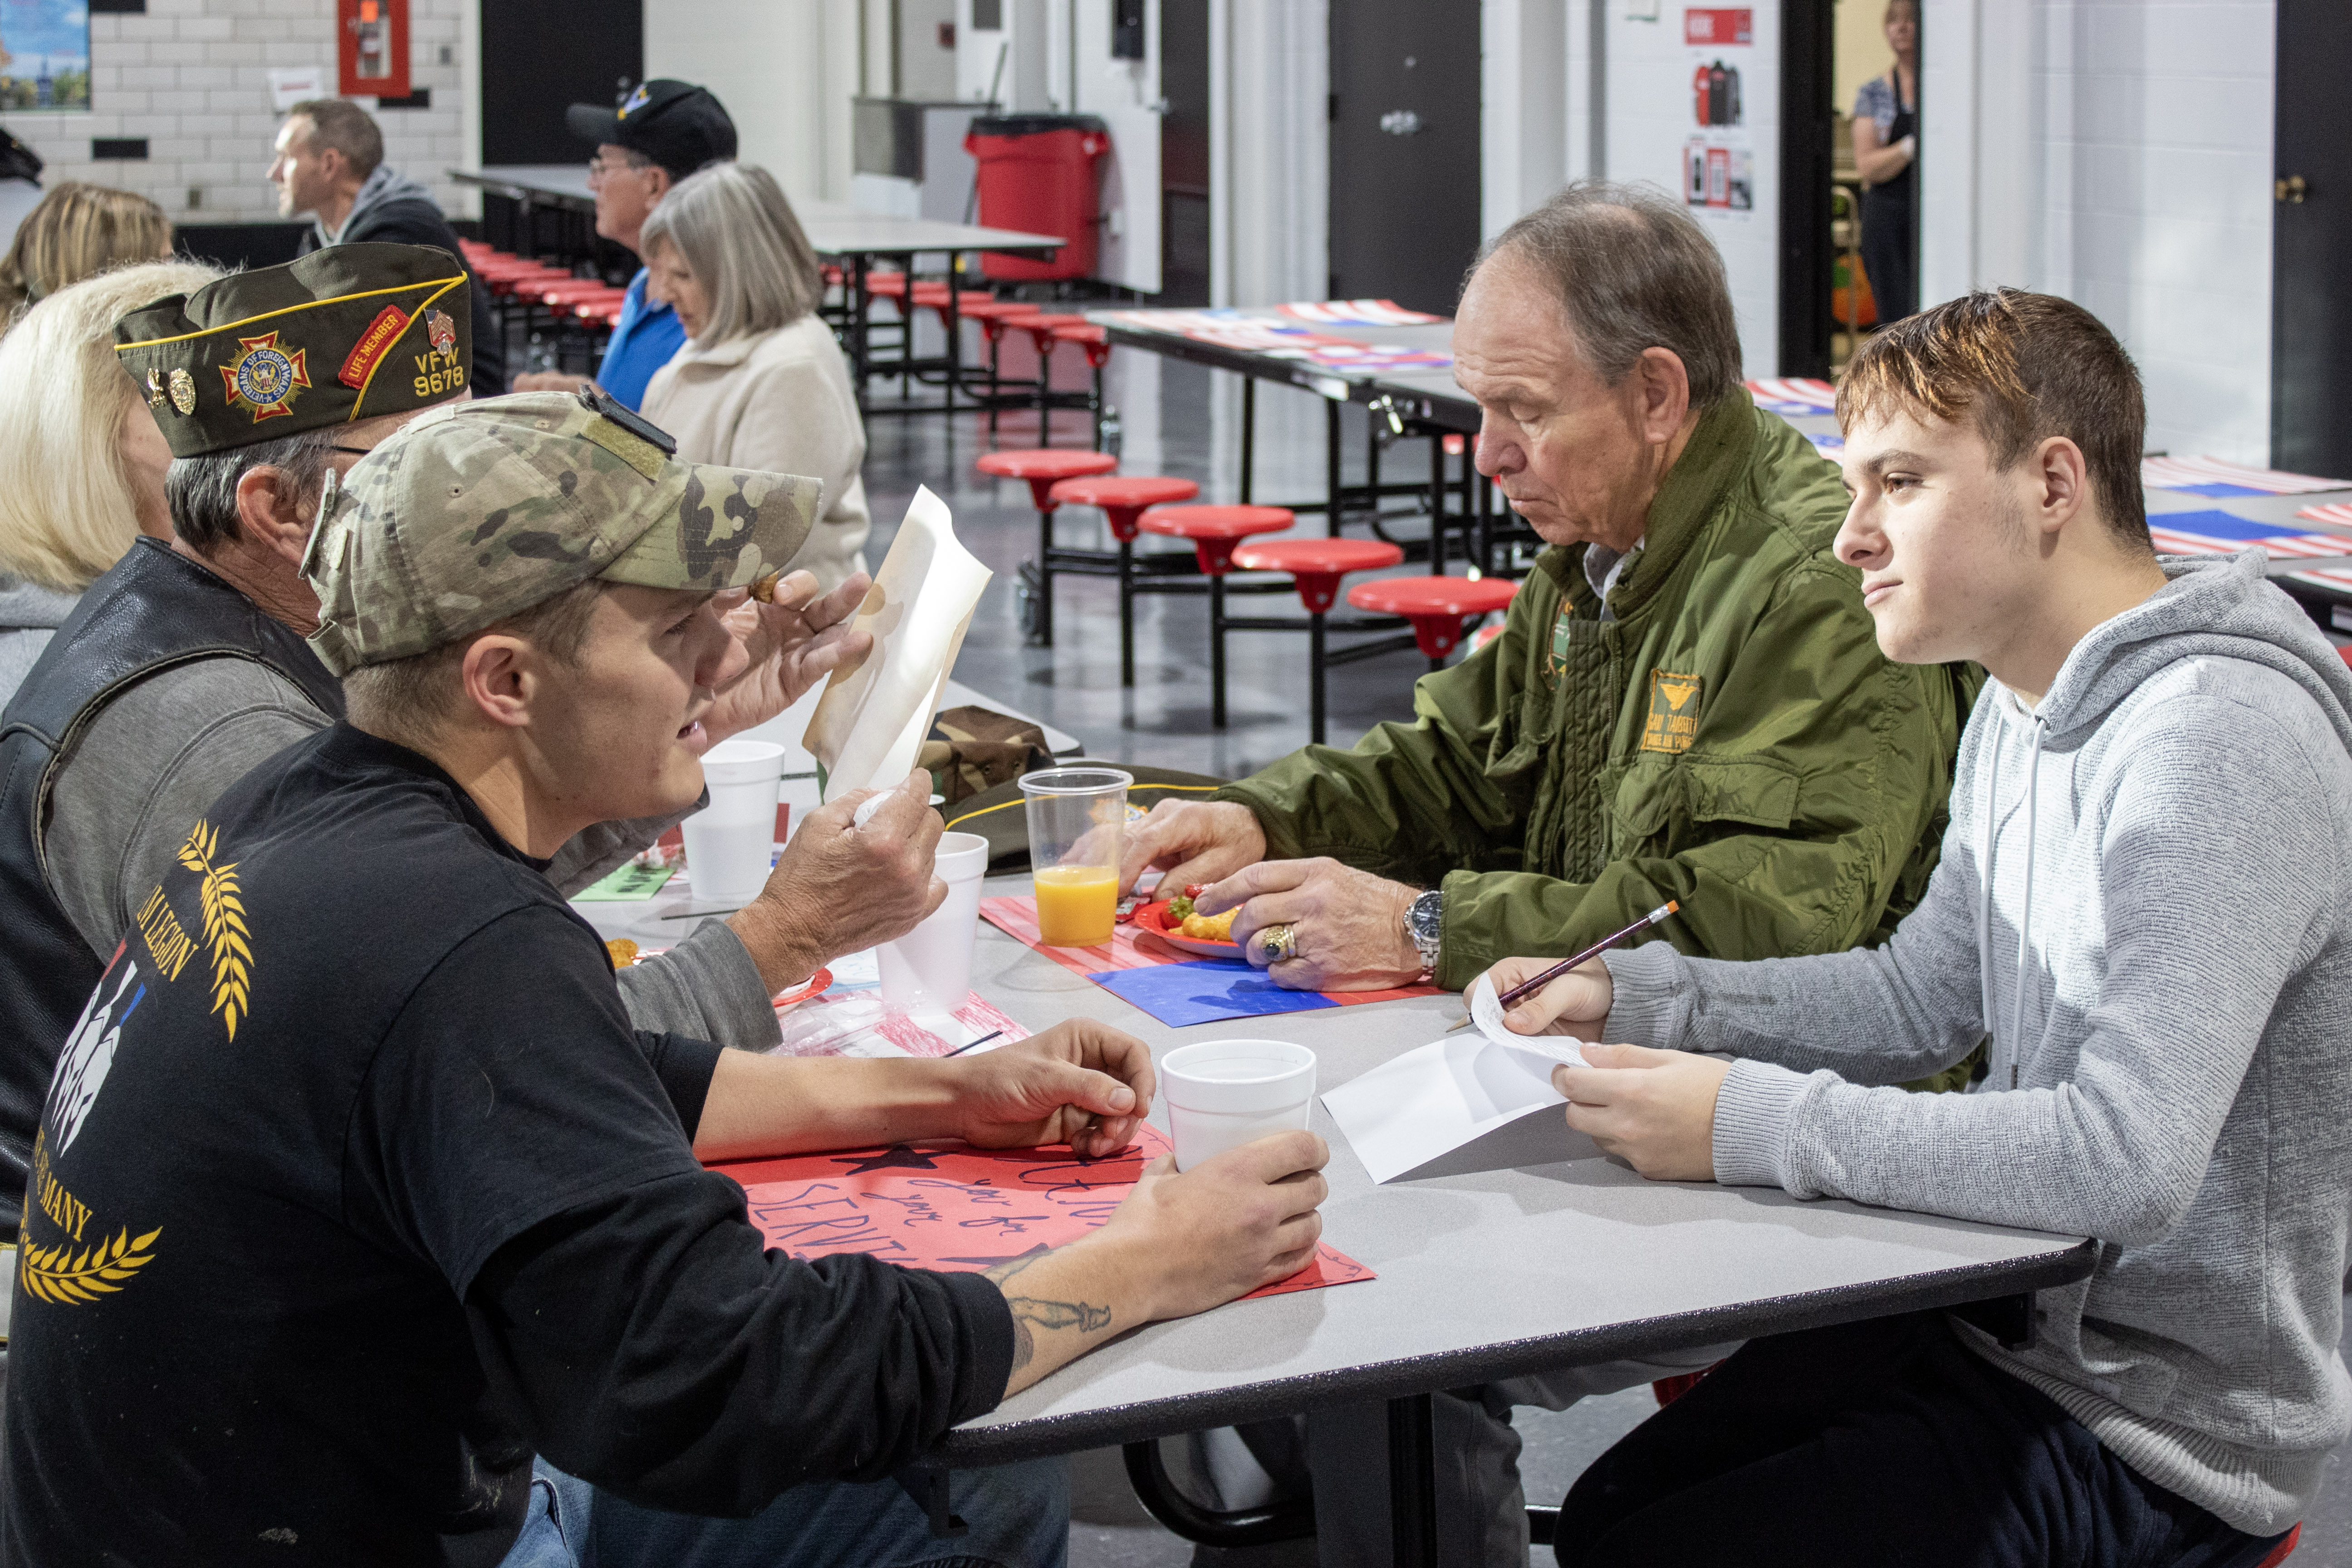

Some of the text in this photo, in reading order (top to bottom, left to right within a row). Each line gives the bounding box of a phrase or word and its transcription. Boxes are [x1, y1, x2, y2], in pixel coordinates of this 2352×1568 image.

[348, 314, 399, 378] LIFE MEMBER
[414, 347, 459, 374] VFW
[239, 350, 291, 404] VETERANS OF FOREIGN WARS
[413, 366, 464, 397] 9678
[143, 901, 199, 982] LEGION
[39, 1170, 93, 1242] MANY
